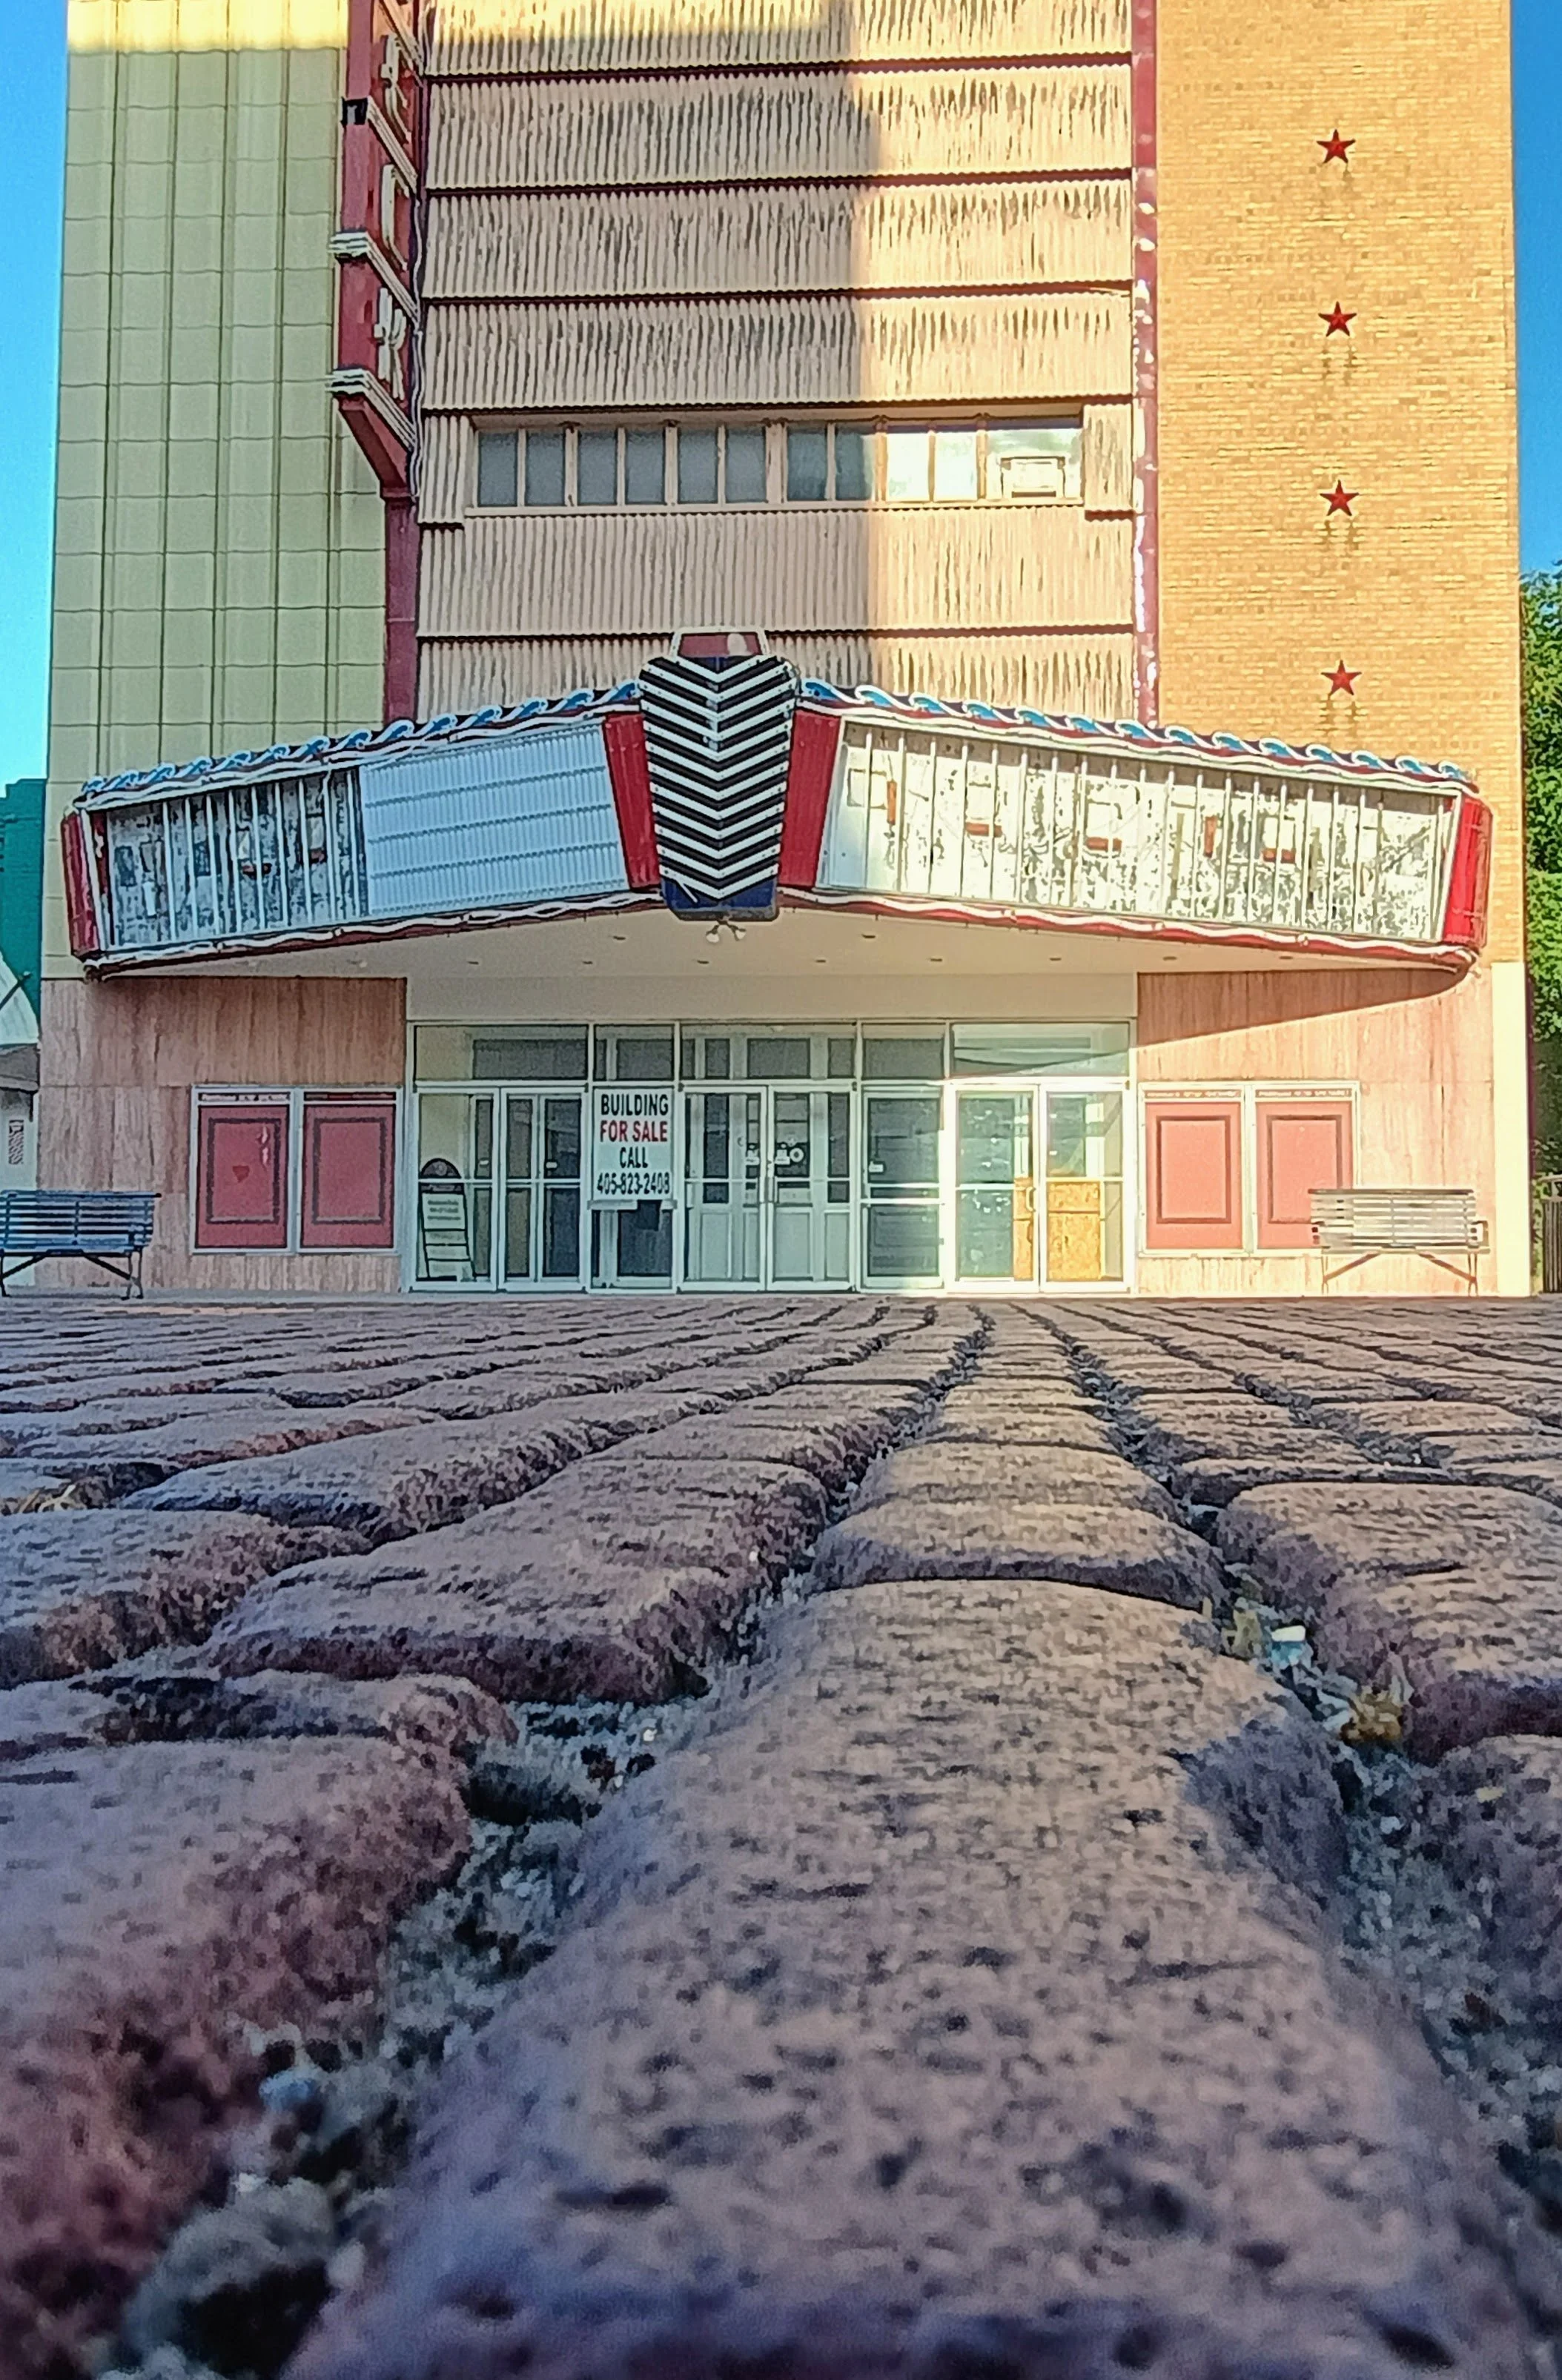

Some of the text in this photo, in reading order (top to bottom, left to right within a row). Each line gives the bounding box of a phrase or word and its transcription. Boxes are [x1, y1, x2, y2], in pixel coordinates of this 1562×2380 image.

[600, 1093, 669, 1116] BUILDING
[600, 1120, 668, 1142] FOR SALE
[619, 1147, 648, 1168] CALL
